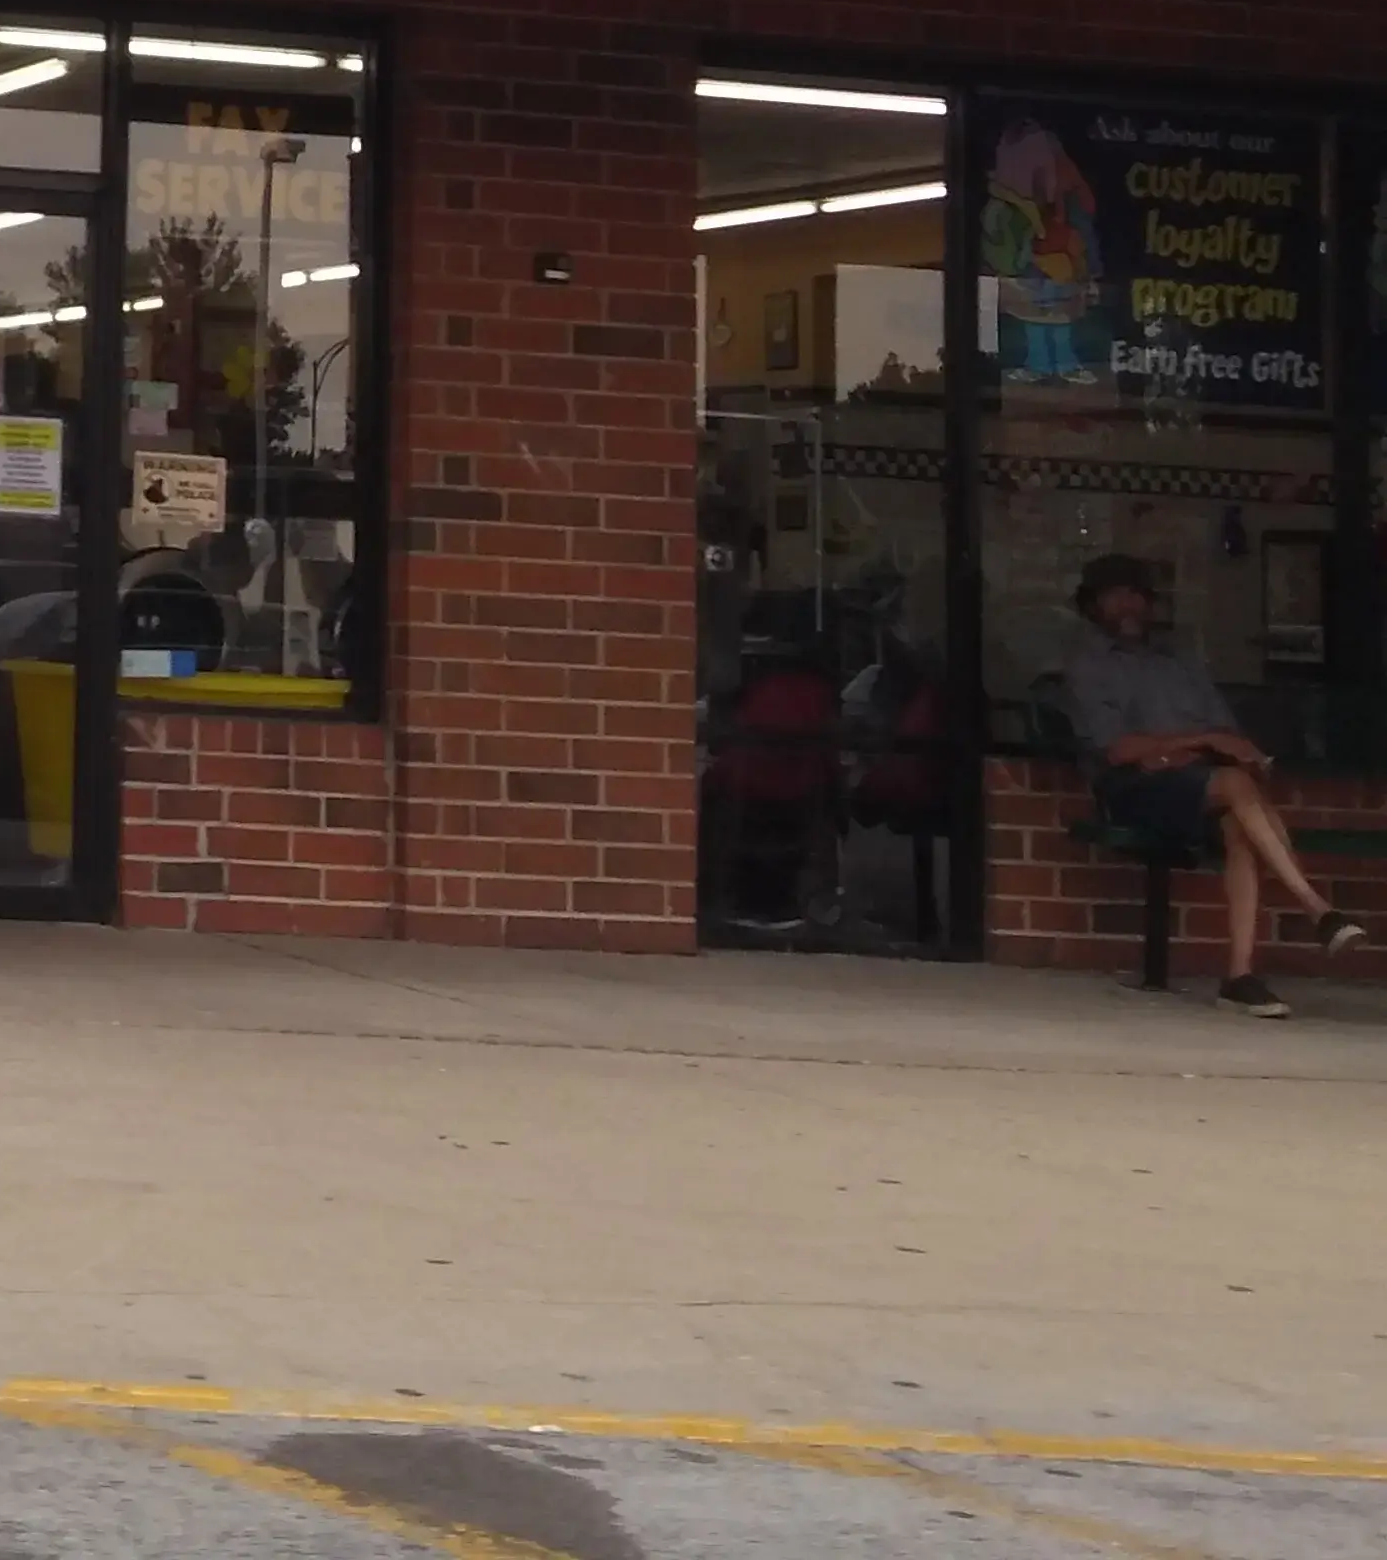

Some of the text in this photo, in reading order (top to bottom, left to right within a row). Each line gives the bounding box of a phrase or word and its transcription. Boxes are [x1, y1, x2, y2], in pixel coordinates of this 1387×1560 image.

[186, 100, 290, 157] FAX
[1145, 121, 1220, 149] about
[1229, 136, 1275, 153] our
[134, 157, 348, 223] SERVICE
[1144, 208, 1283, 273] loyalty
[1130, 277, 1300, 328] program
[1110, 339, 1177, 376] Earn
[1252, 350, 1322, 389] Gifts
